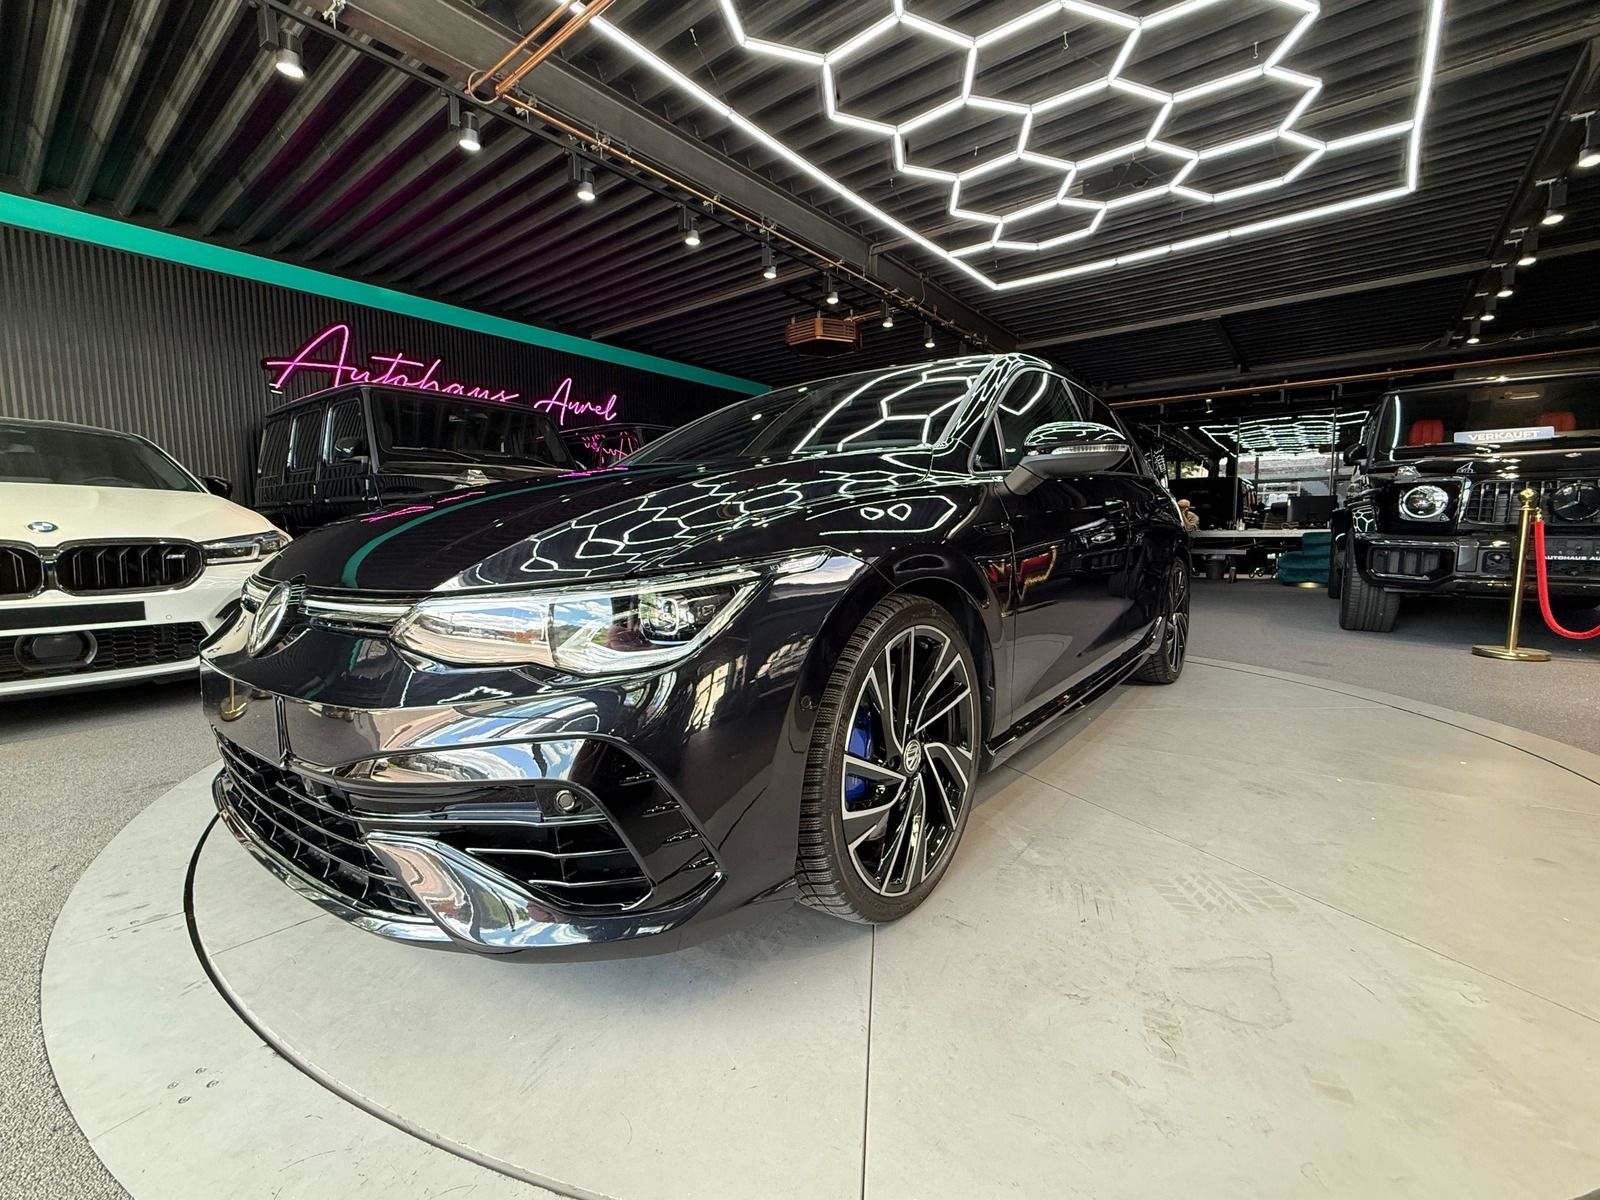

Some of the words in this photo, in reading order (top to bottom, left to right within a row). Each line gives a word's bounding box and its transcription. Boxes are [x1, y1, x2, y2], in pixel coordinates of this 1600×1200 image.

[266, 324, 520, 402] Autohaus
[533, 377, 618, 426] Aurel
[1468, 430, 1540, 441] VERKAUFT
